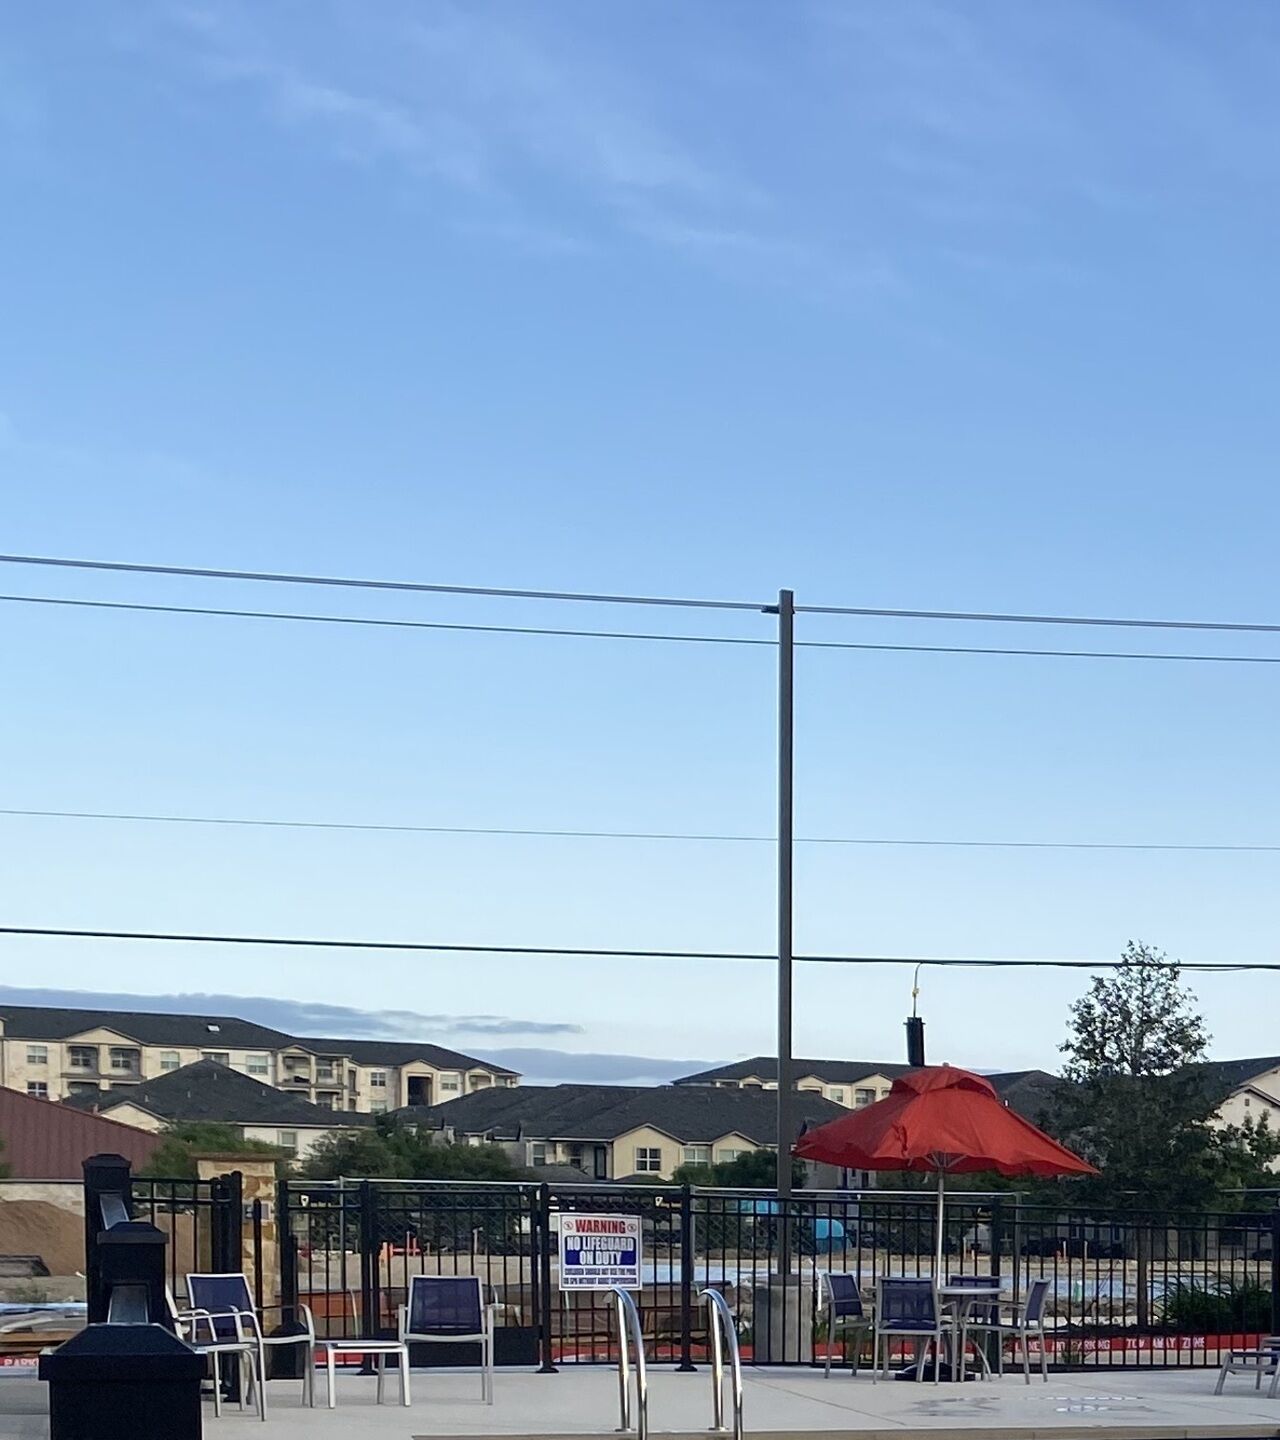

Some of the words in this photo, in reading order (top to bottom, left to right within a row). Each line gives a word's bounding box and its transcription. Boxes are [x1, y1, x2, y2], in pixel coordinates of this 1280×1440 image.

[575, 1219, 626, 1234] WARNING
[567, 1236, 580, 1251] NO
[582, 1237, 634, 1251] LIFEGUARD
[579, 1251, 594, 1265] ON
[595, 1251, 622, 1265] DUTY
[1014, 1341, 1040, 1351] LNE
[1070, 1340, 1111, 1350] PARKNG
